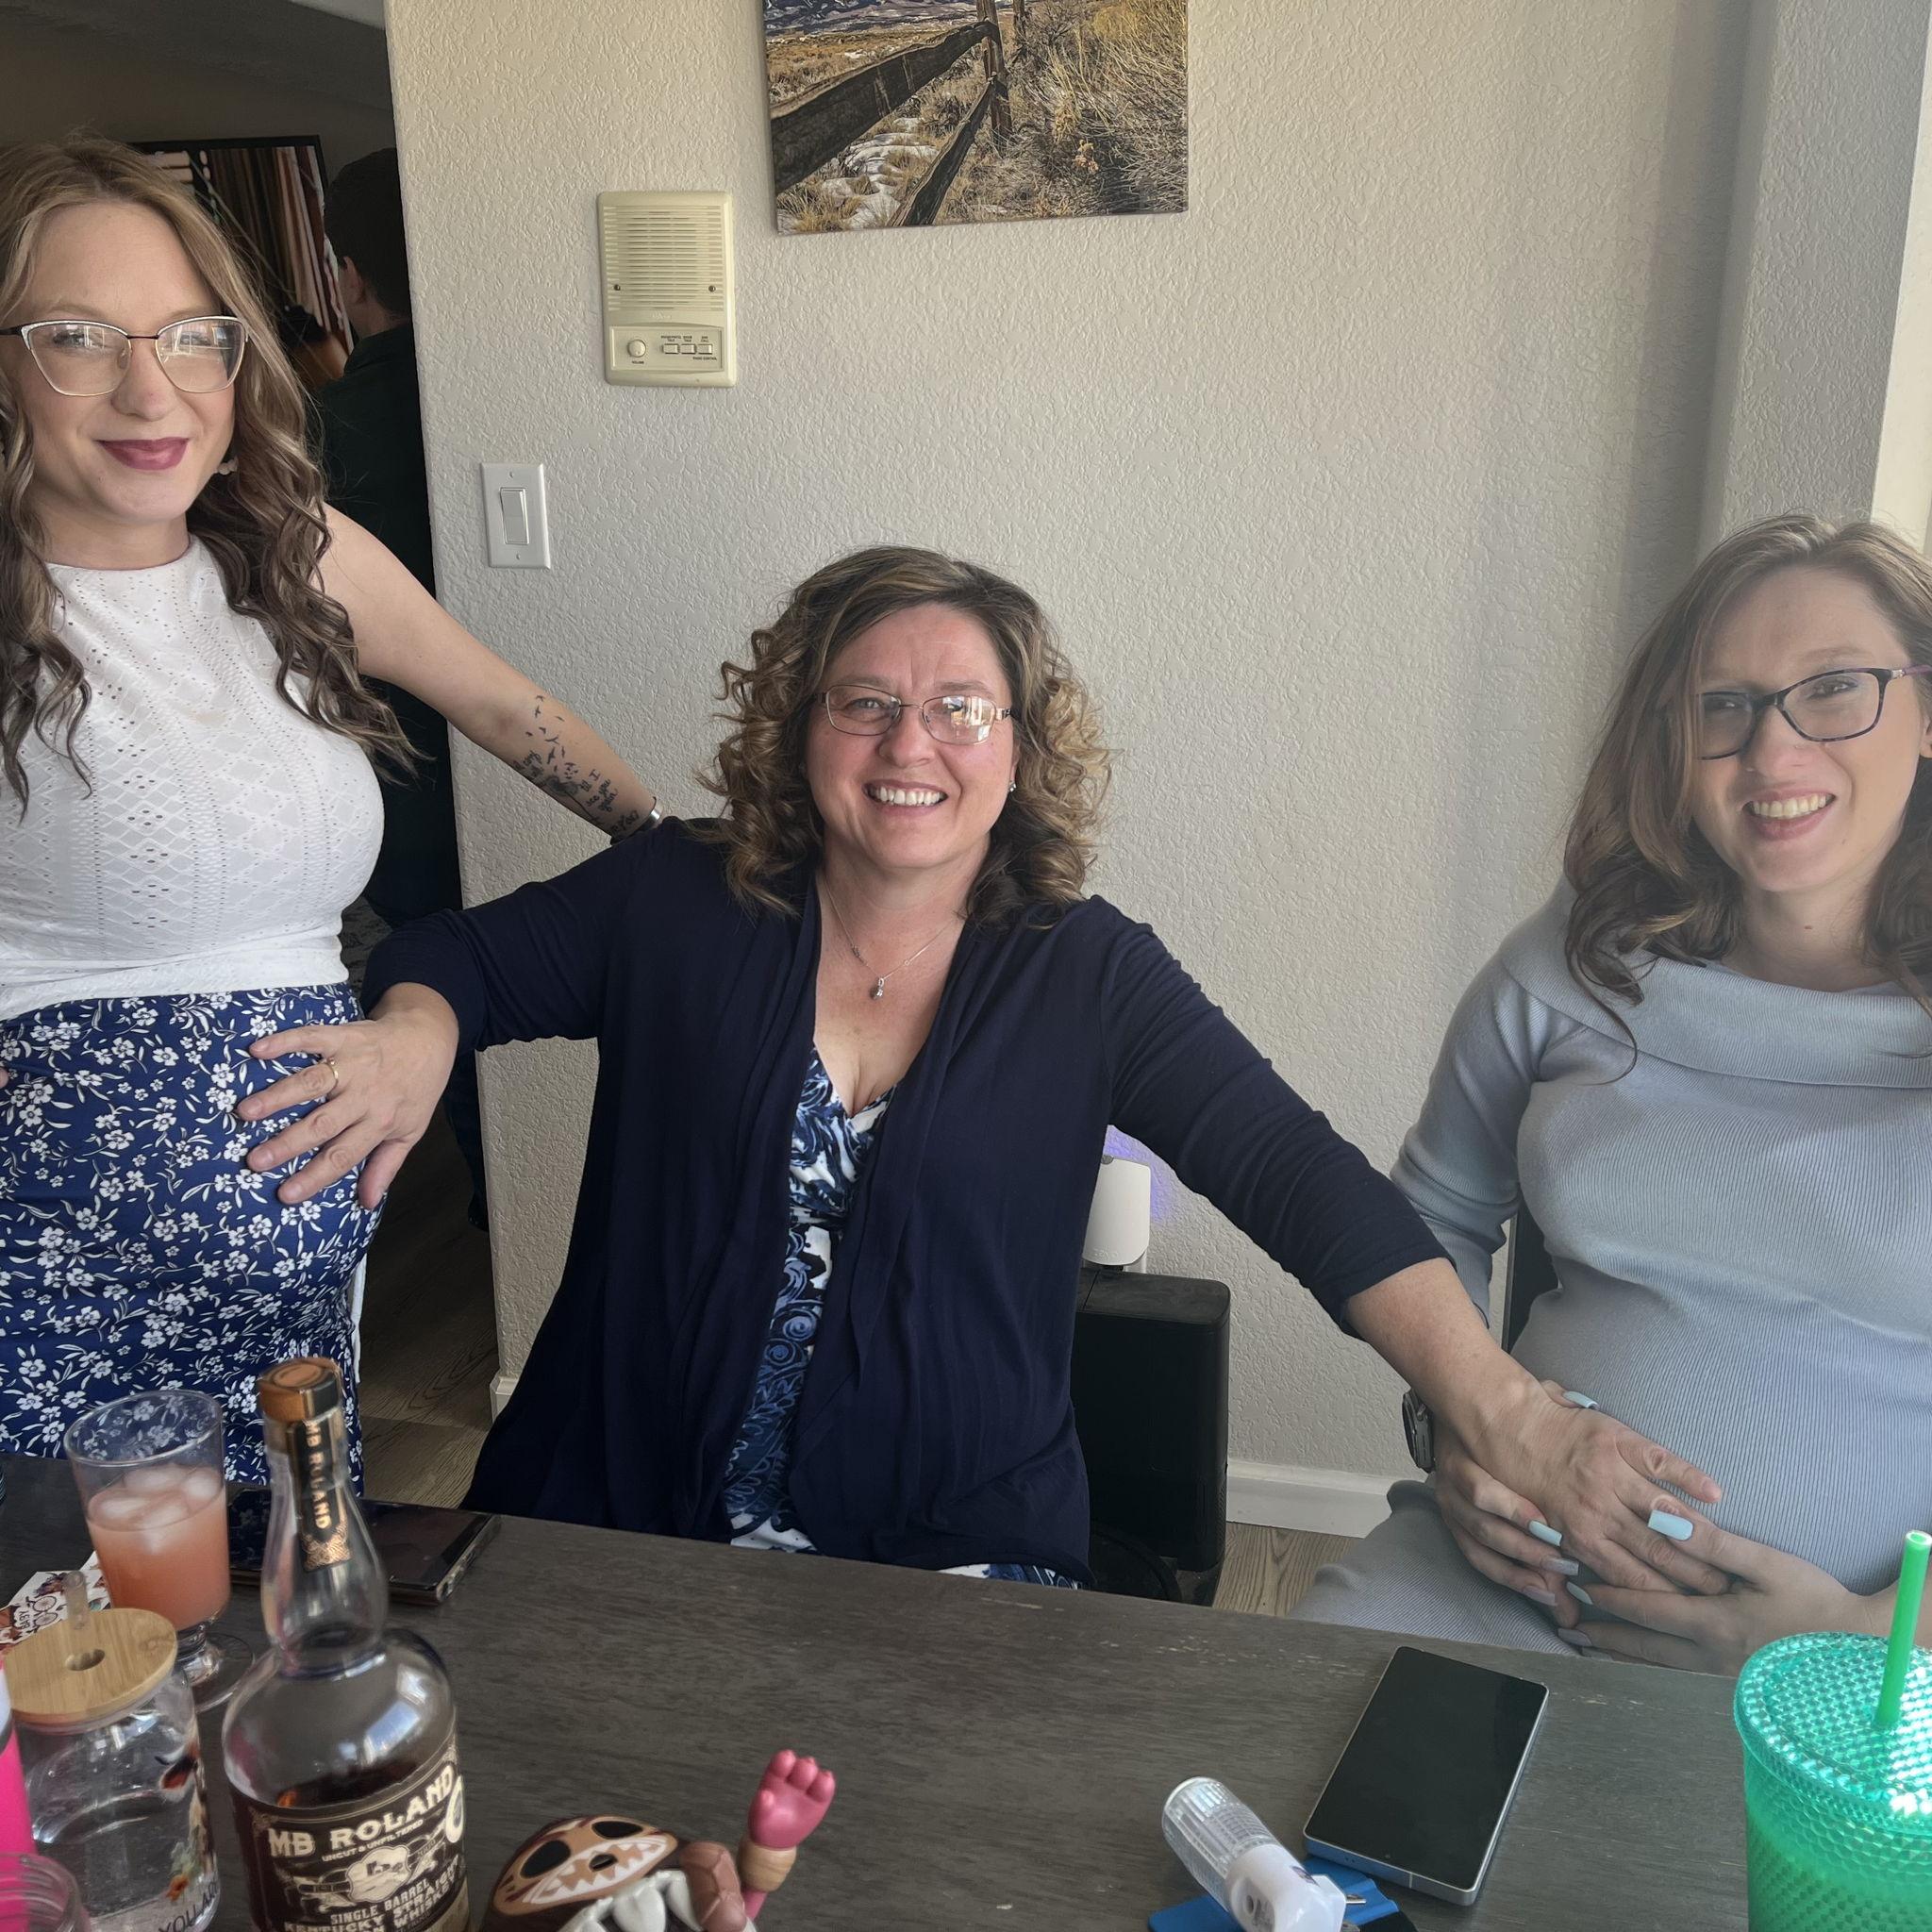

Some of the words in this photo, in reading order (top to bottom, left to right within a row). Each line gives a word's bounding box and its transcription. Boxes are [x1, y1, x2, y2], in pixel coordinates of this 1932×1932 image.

[308, 1451, 332, 1529] ROLAND
[267, 1827, 316, 1858] MB
[329, 1764, 454, 1851] ROLAND
[322, 1848, 358, 1863] UNCUT
[329, 1905, 378, 1926] SINGLE
[384, 1877, 430, 1912] BARREL
